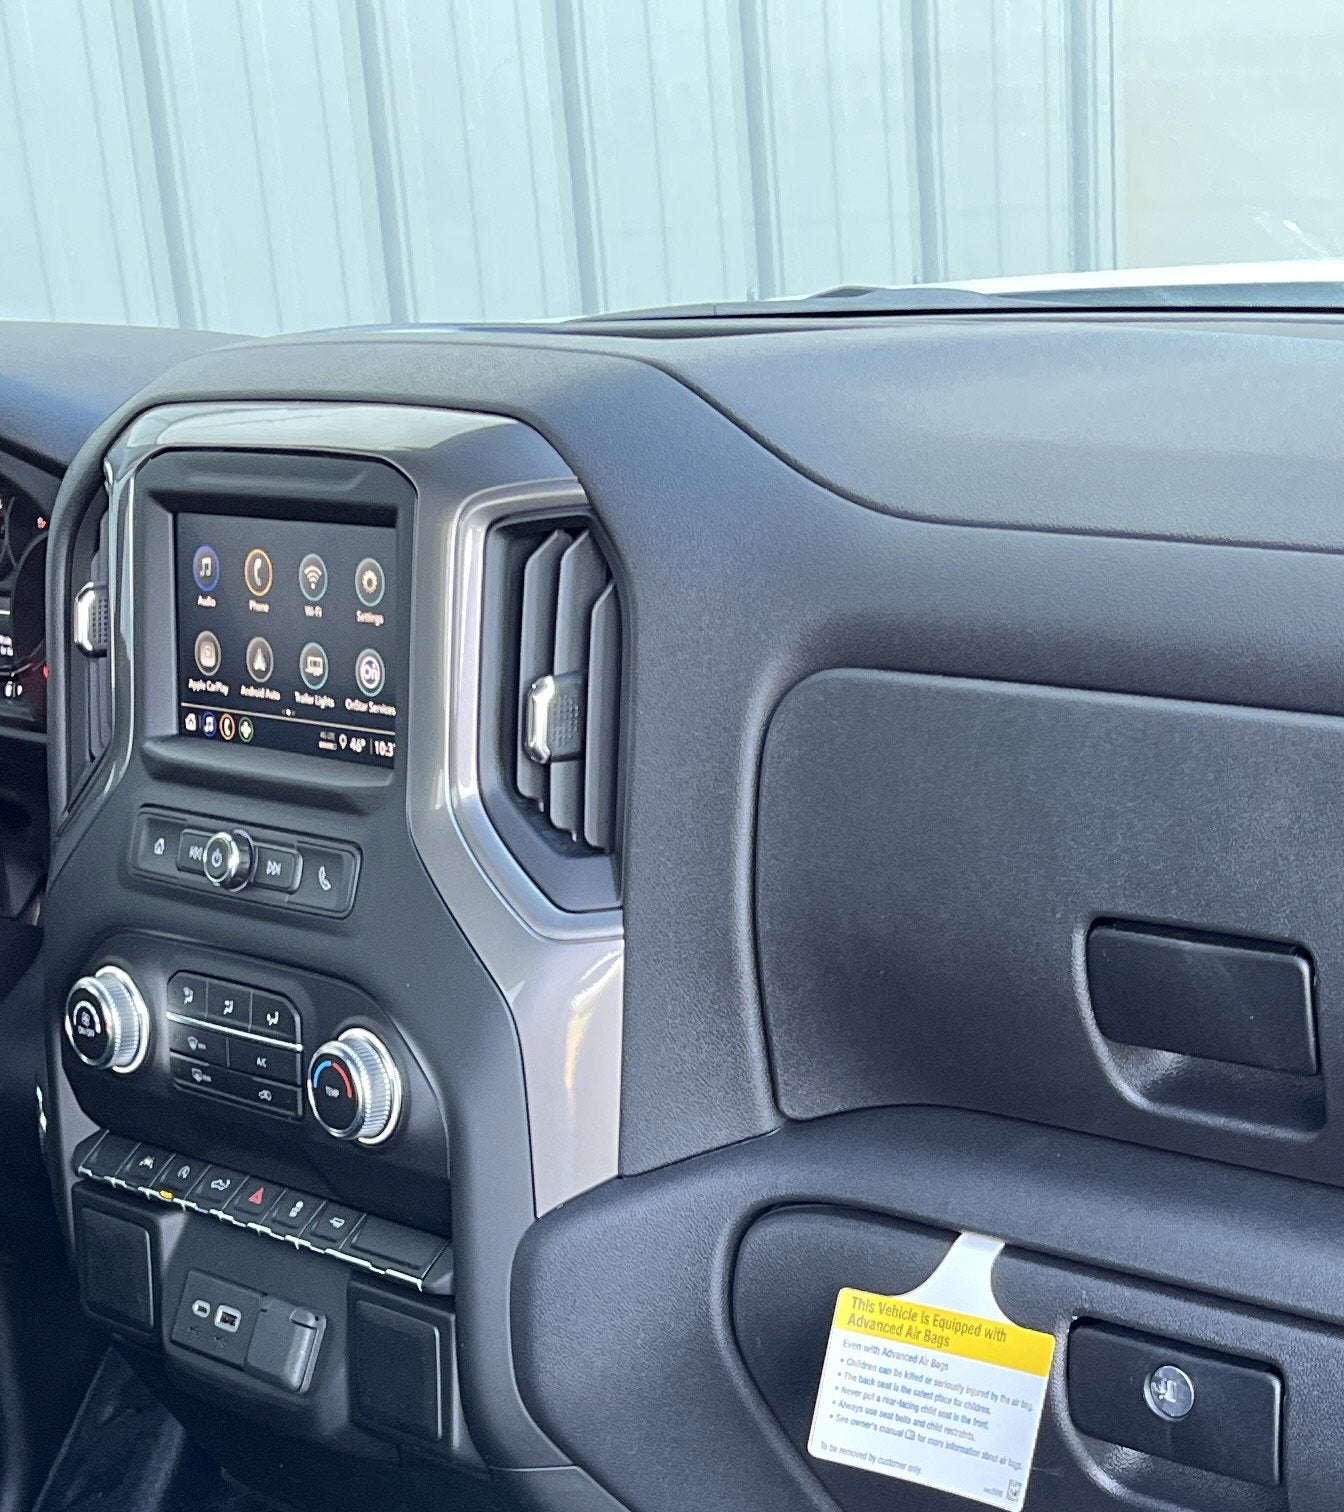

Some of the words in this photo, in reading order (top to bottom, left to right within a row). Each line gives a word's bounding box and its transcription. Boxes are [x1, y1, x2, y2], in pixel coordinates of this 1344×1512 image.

[356, 610, 384, 626] Settings
[240, 685, 265, 698] Android
[368, 701, 396, 717] Services
[374, 740, 396, 758] 10:3
[847, 1311, 903, 1337] Advanced
[904, 1324, 922, 1340] Air
[922, 1329, 951, 1350] Bags
[850, 1296, 875, 1313] This
[876, 1301, 918, 1323] Vehicle
[931, 1313, 981, 1339] Equipped
[983, 1325, 1007, 1343] with
[842, 1338, 861, 1351] Even
[863, 1343, 880, 1355] with
[881, 1347, 918, 1363] Advanced
[918, 1355, 929, 1365] Air
[930, 1358, 949, 1373] Bags
[844, 1371, 856, 1381] The
[858, 1374, 875, 1386] back
[876, 1379, 892, 1390] seat
[900, 1384, 911, 1394] the
[913, 1387, 933, 1400] safest
[933, 1393, 952, 1405] place
[953, 1397, 963, 1407] for
[846, 1356, 877, 1372] Children
[878, 1366, 891, 1375] can
[893, 1368, 903, 1377] be
[904, 1370, 923, 1382] killed
[924, 1377, 932, 1385] or
[933, 1377, 964, 1395] seriously
[989, 1391, 998, 1403] by
[837, 1399, 863, 1414] Always
[864, 1407, 877, 1416] use
[879, 1409, 893, 1420] seat
[895, 1413, 911, 1424] belts
[912, 1418, 925, 1427] and
[926, 1420, 942, 1432] child
[840, 1386, 861, 1397] Never
[863, 1391, 874, 1401] put
[882, 1395, 919, 1413] rear-facing
[920, 1404, 937, 1416] child
[937, 1409, 951, 1419] seat
[953, 1412, 959, 1421] in
[960, 1414, 971, 1424] the
[835, 1413, 849, 1424] See
[879, 1423, 903, 1437] manual
[917, 1433, 925, 1442] for
[944, 1440, 980, 1457] information
[829, 1443, 837, 1452] be
[839, 1445, 867, 1460] removed
[868, 1453, 876, 1464] by
[877, 1455, 906, 1470] customer
